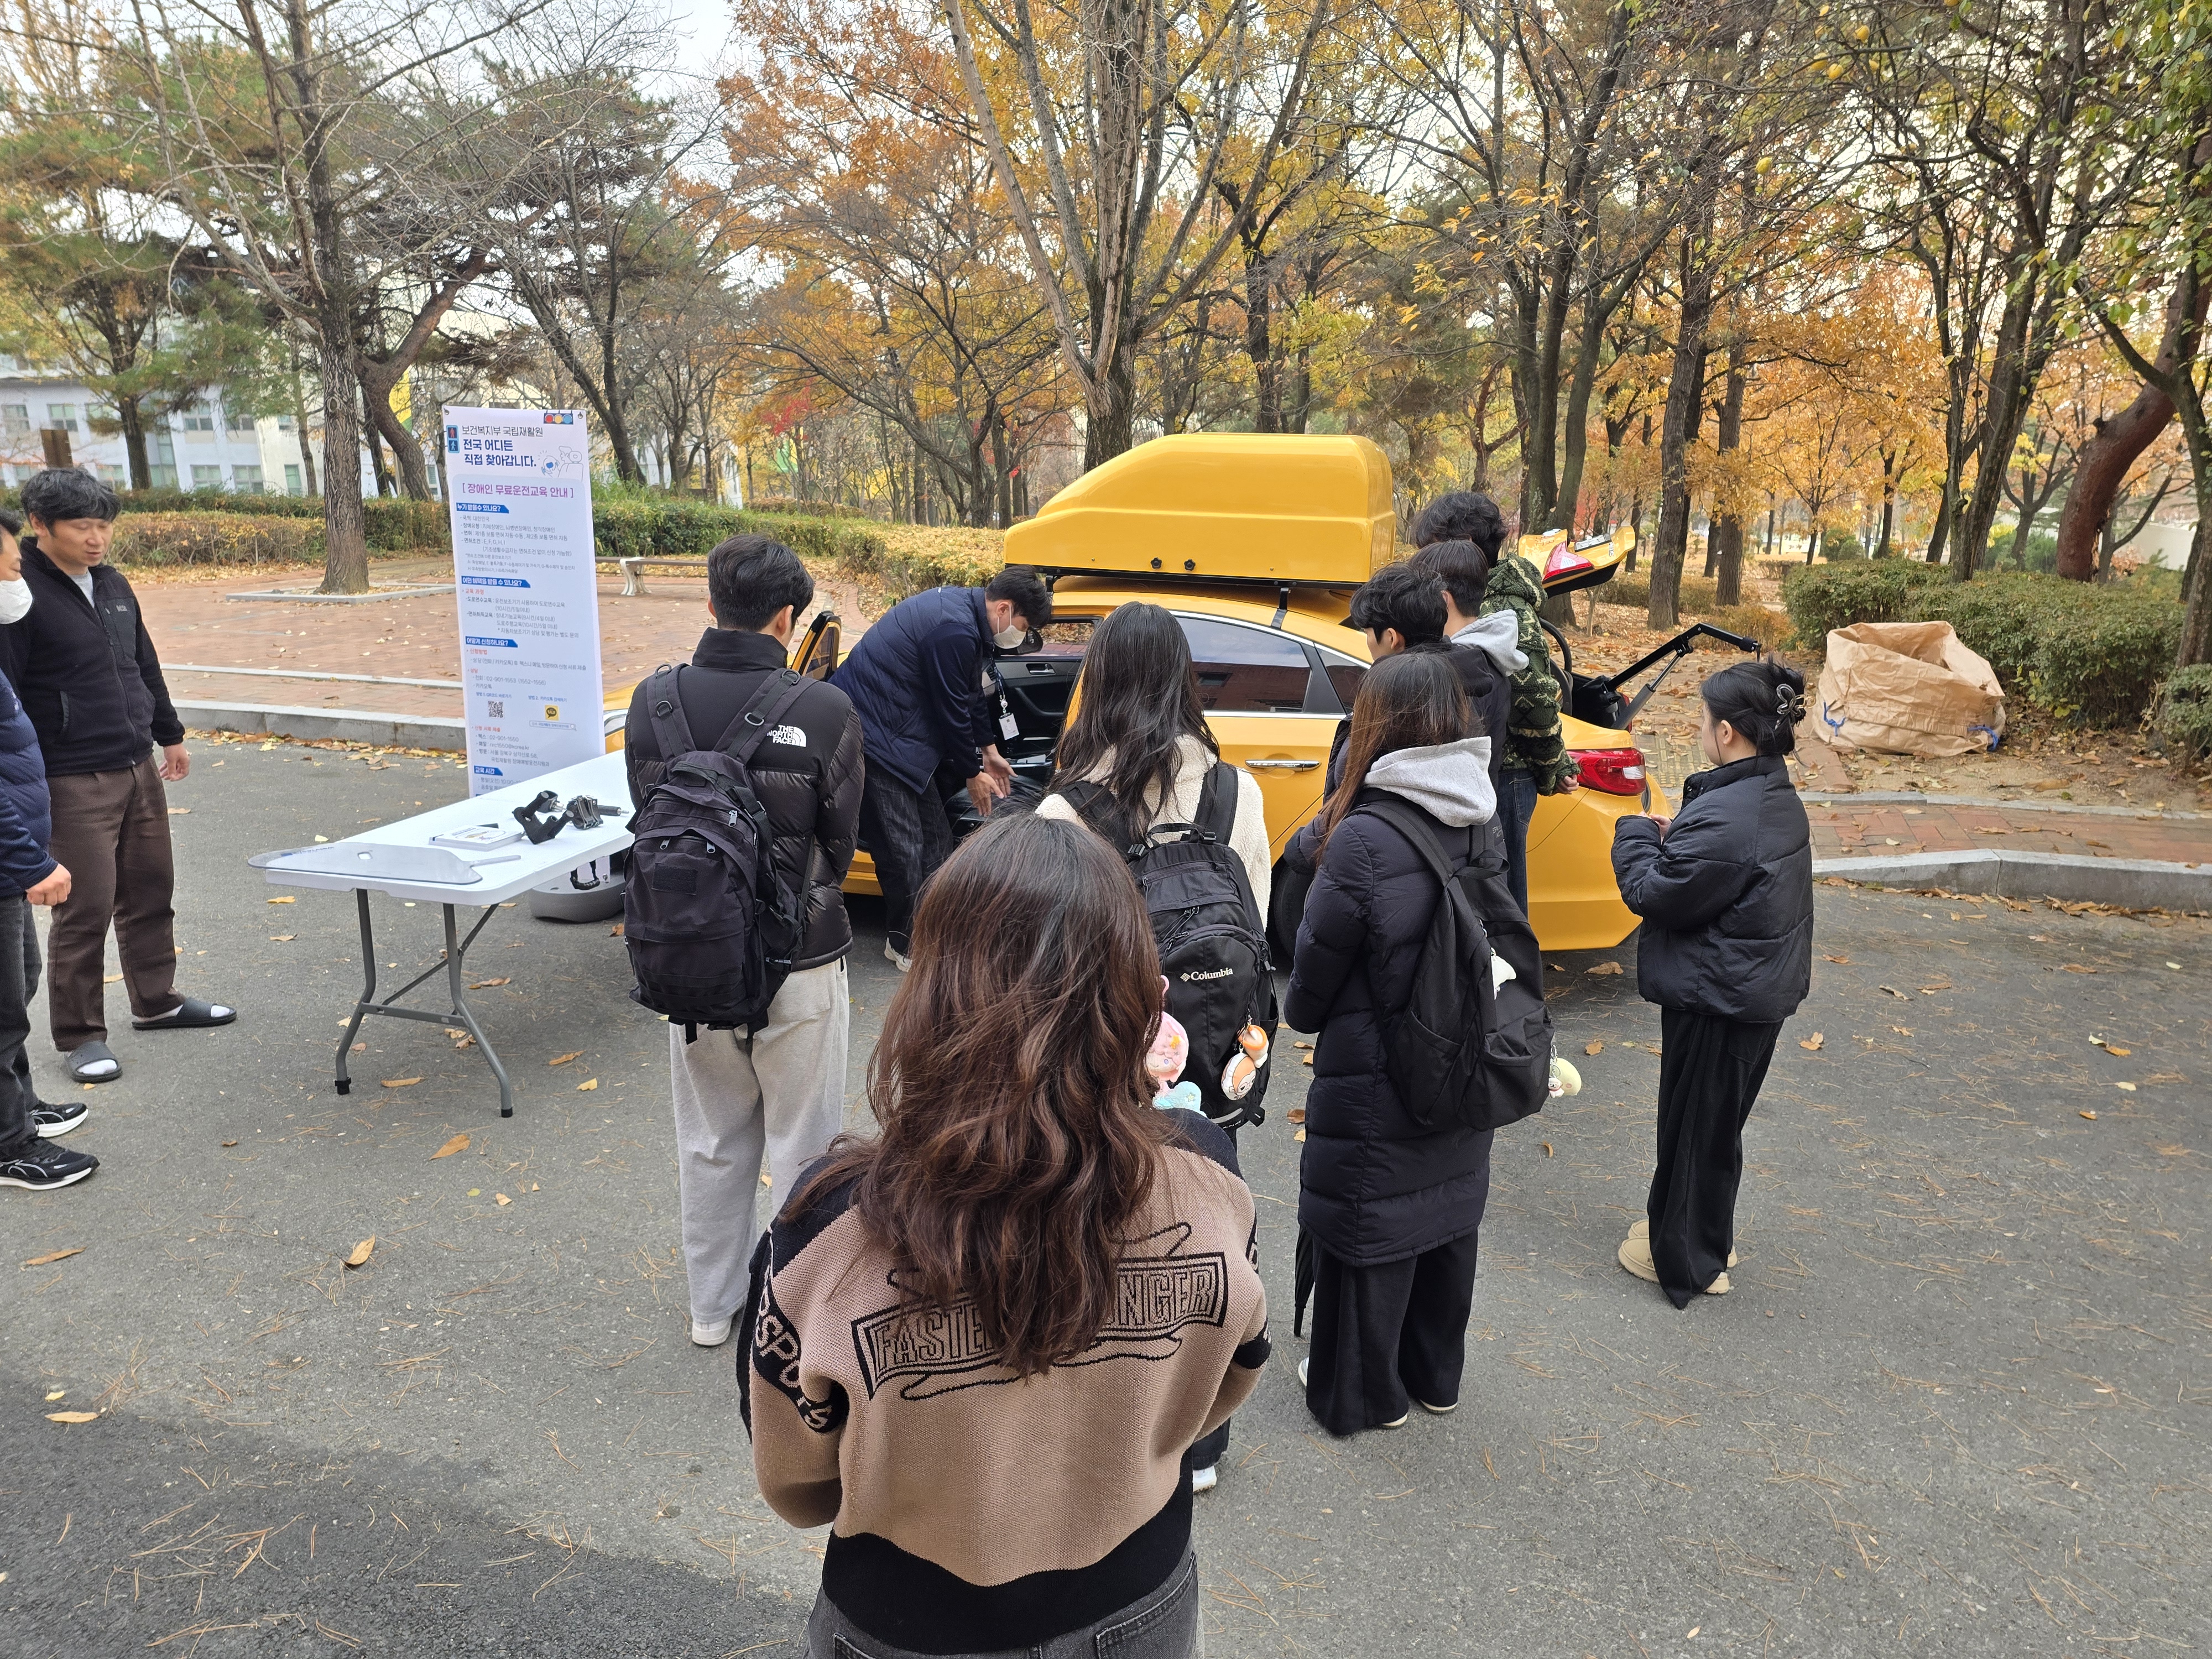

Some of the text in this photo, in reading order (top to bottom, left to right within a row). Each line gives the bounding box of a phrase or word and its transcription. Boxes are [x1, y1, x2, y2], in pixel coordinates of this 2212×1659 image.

[462, 425, 543, 437] 보건복지부 국립재활원
[463, 439, 513, 451] 전국 어디든
[464, 453, 536, 467] 직접 찾아갑니다.
[467, 483, 493, 494] 장애인
[495, 485, 547, 497] 무료운전교육
[550, 487, 567, 498] 안내
[766, 730, 793, 739] NORTH
[778, 724, 794, 733] THE
[773, 736, 793, 745] FACE
[1190, 967, 1233, 980] Columbia
[875, 1306, 995, 1371] FASTE
